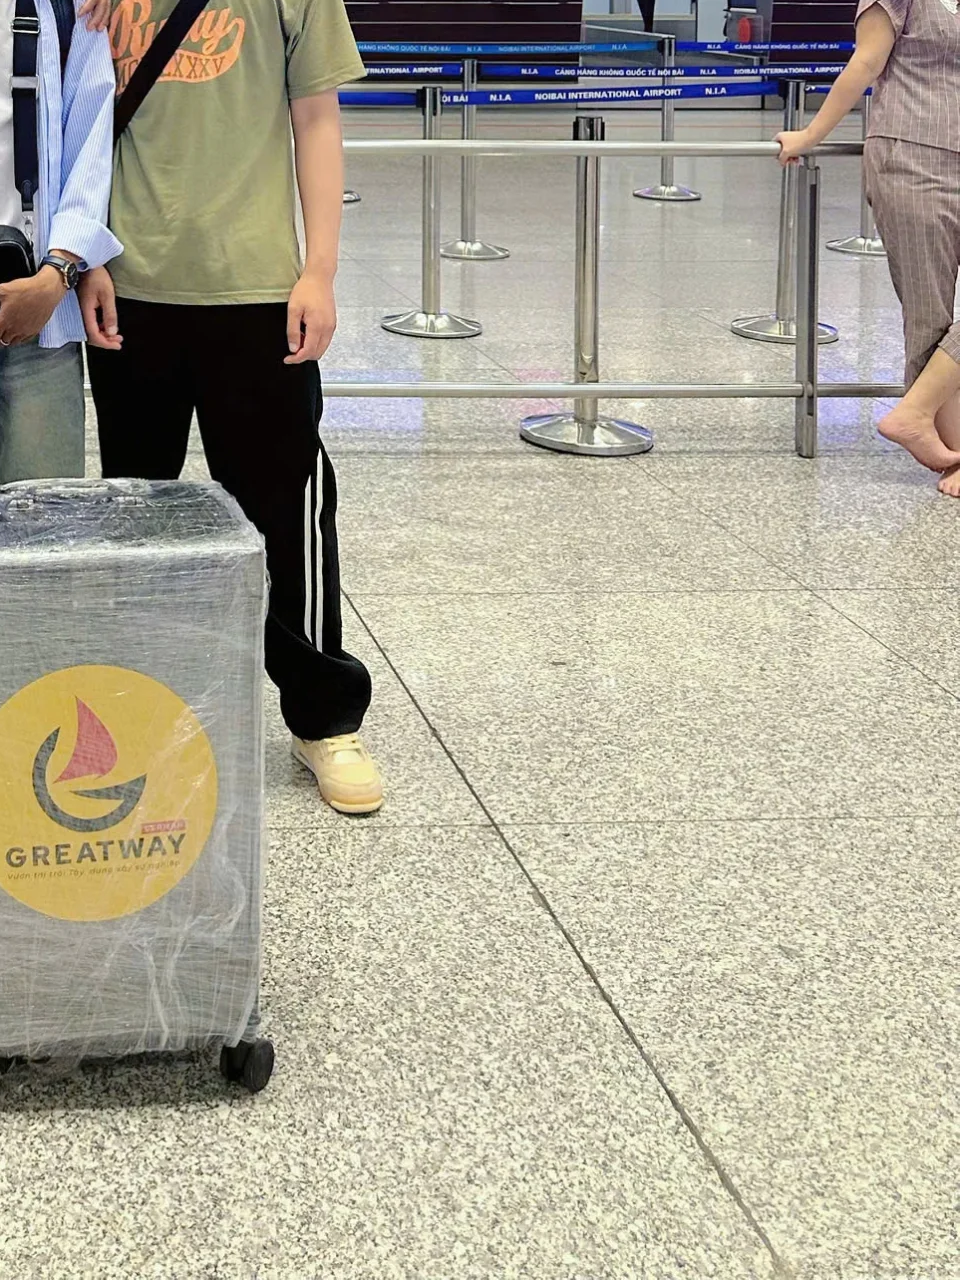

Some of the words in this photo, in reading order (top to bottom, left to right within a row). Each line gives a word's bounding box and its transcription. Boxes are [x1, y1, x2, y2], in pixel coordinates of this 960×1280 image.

[599, 68, 624, 76] KHÔNG
[568, 90, 641, 99] INTERNATIONAL
[643, 89, 682, 97] AIRPORT
[705, 87, 727, 95] N.I.A
[5, 833, 186, 868] GREATWAY
